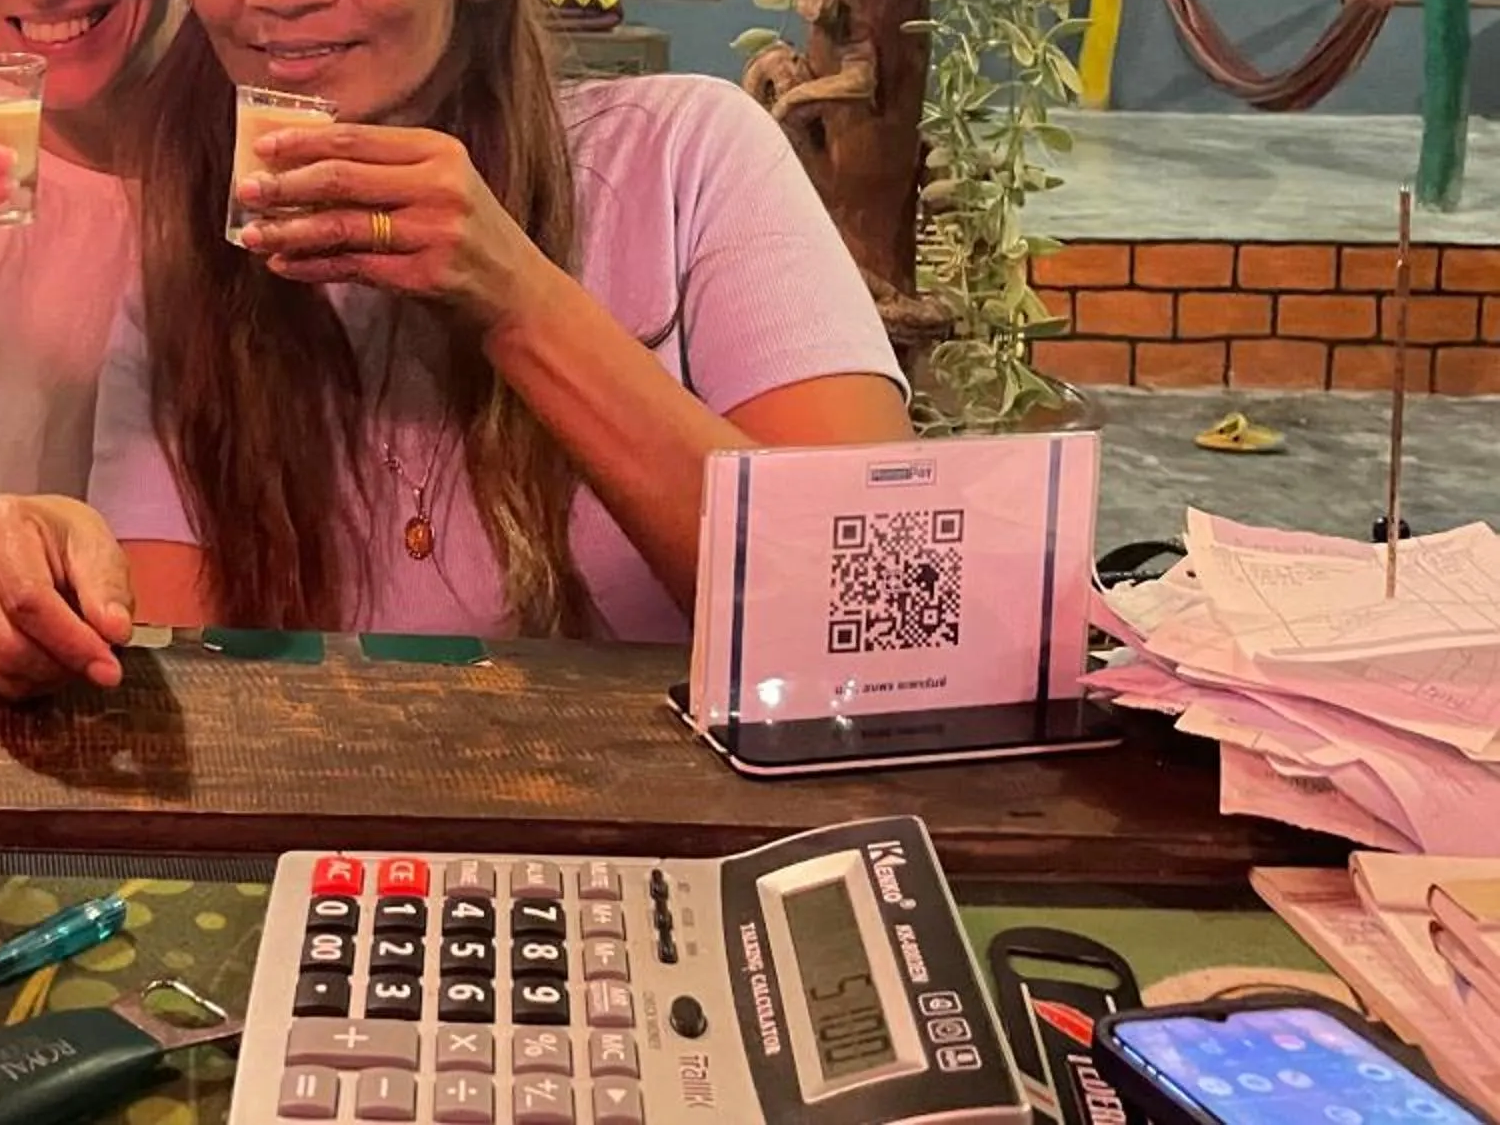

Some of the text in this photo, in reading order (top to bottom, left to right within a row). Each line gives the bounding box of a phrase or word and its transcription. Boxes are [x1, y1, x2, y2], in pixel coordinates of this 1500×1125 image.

[327, 860, 351, 881] AC
[389, 861, 414, 882] CE
[315, 900, 349, 916] 0
[383, 903, 417, 915] 1
[451, 902, 485, 918] 4
[523, 905, 557, 921] 7
[592, 904, 613, 924] M+
[311, 934, 343, 960] 00
[379, 941, 414, 956] 2
[451, 942, 485, 959] 5
[522, 942, 559, 960] 8
[375, 983, 411, 998] 3
[448, 984, 485, 1002] 6
[522, 985, 561, 1003] 9
[740, 922, 781, 1057] TALKING CALCULATOR
[809, 974, 889, 1063] 5100
[601, 1034, 625, 1061] MC
